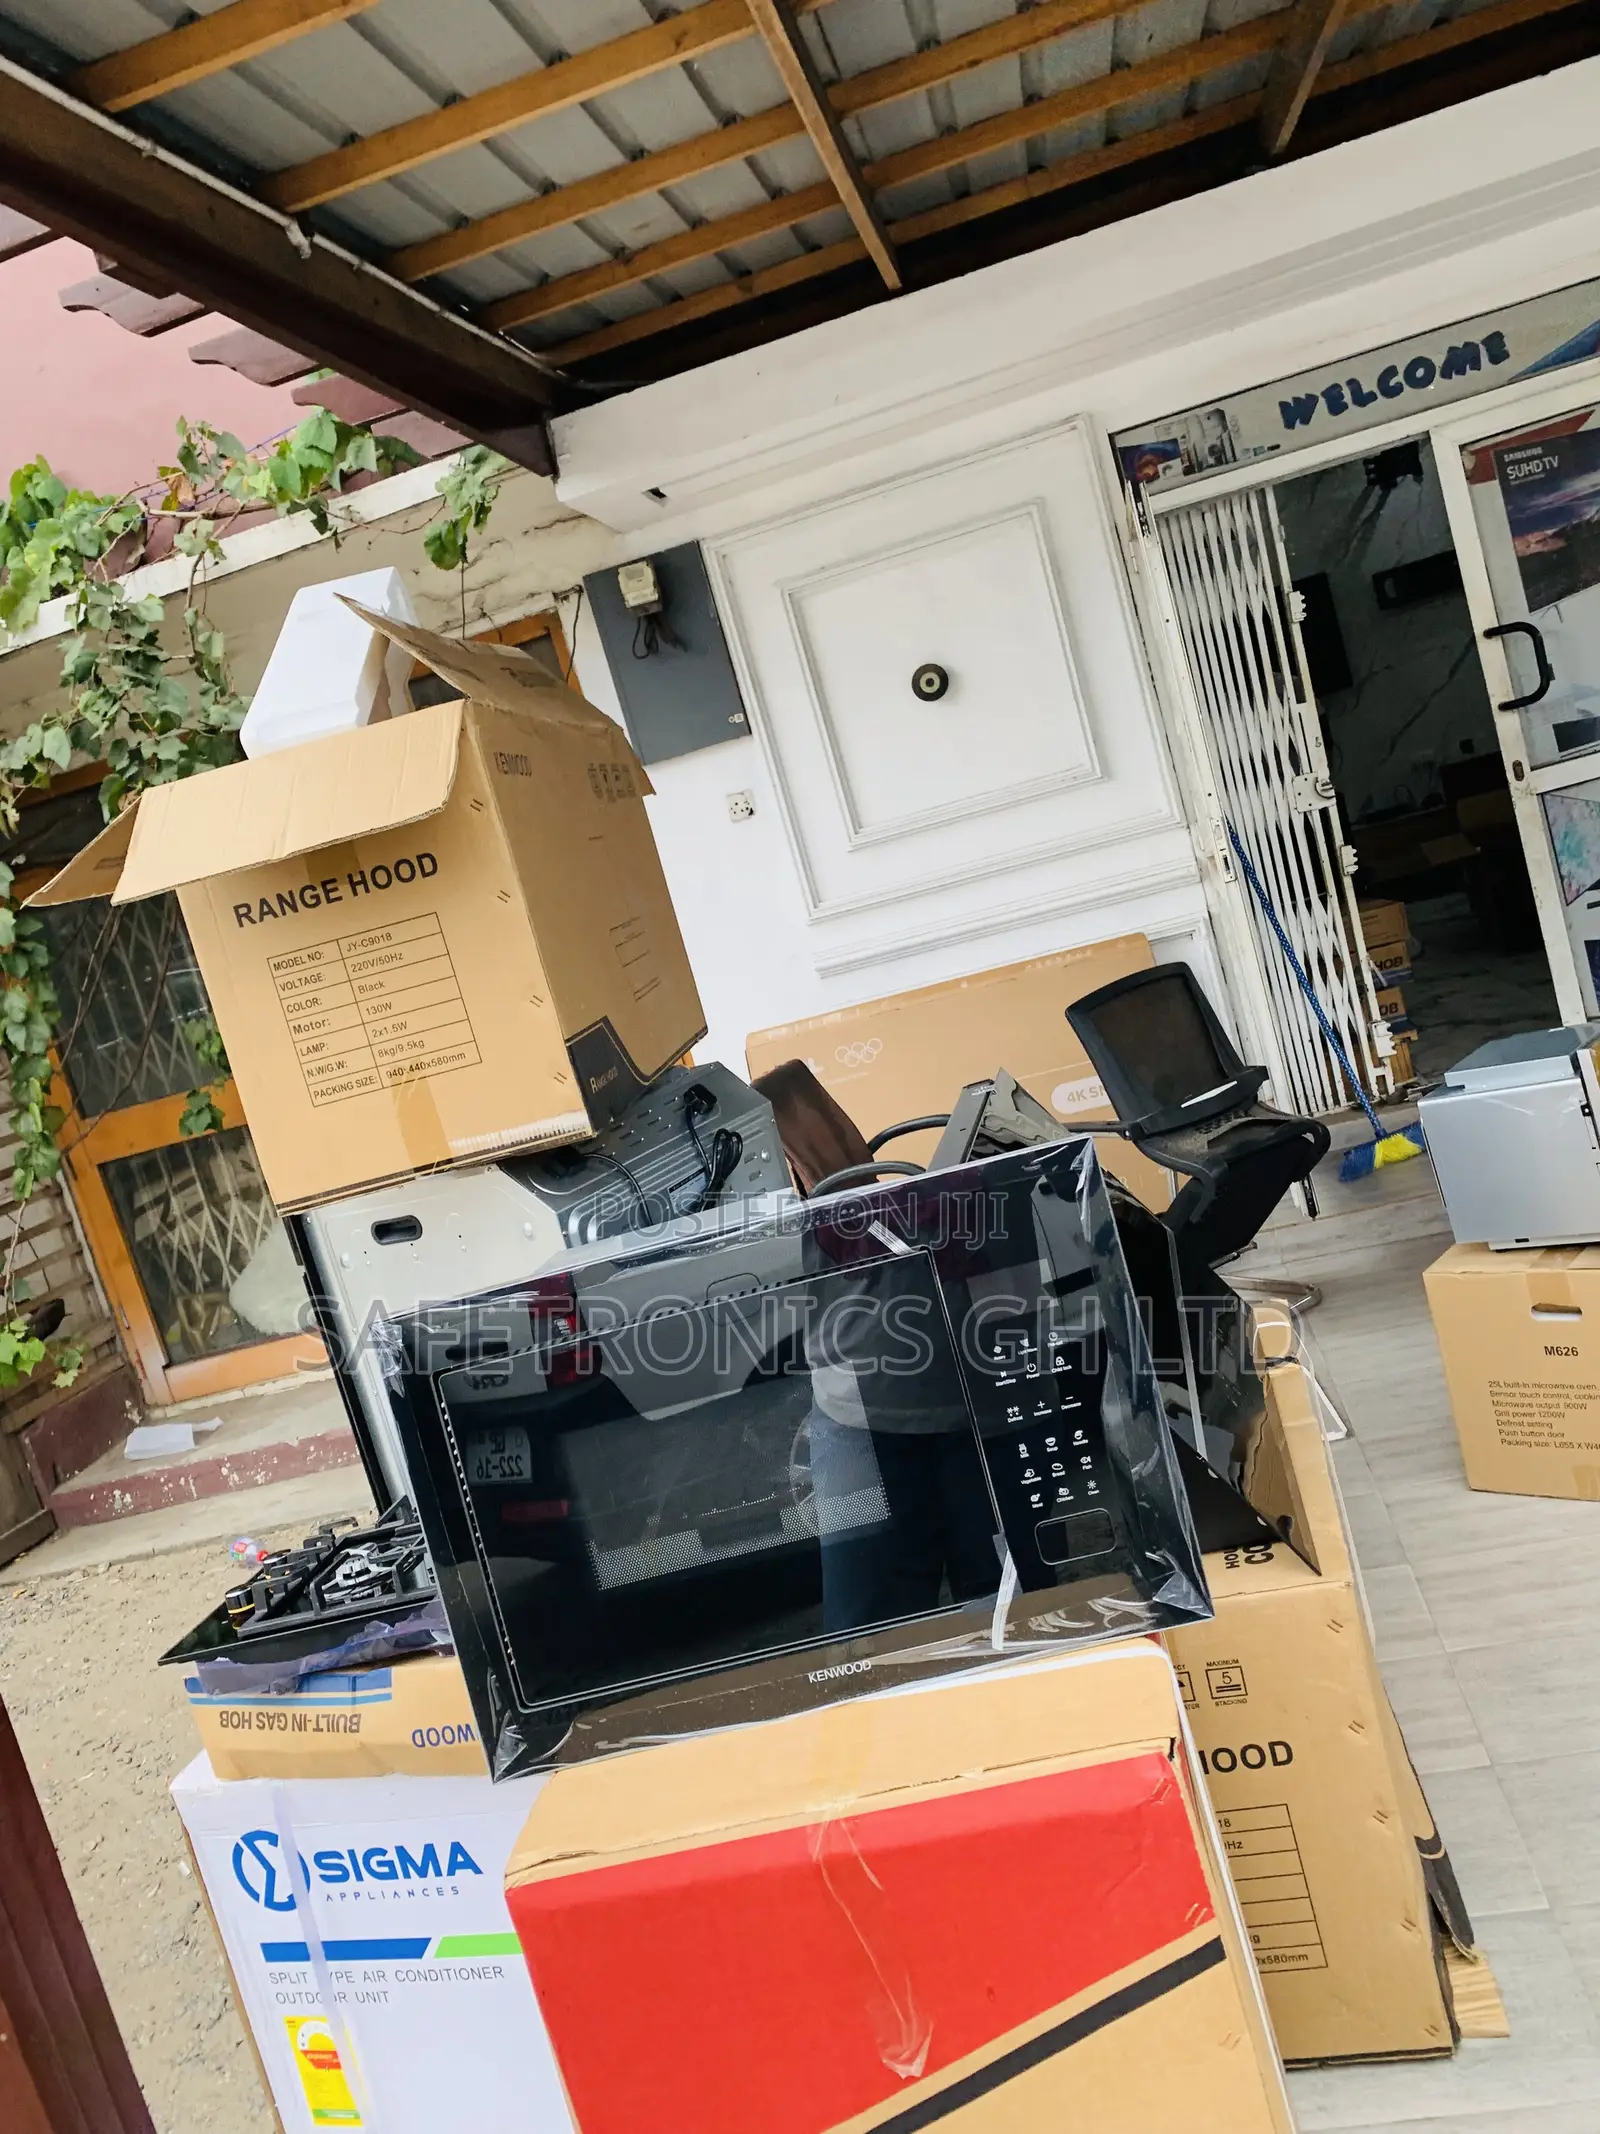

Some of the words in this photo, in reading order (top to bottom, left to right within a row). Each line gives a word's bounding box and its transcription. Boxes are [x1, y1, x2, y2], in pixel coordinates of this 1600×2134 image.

[1278, 330, 1511, 430] WELCOME
[1506, 459, 1543, 480] SUHD
[1542, 455, 1559, 470] TV
[233, 878, 343, 928] RANGE
[347, 852, 439, 898] HOOD
[346, 932, 393, 953] JY-C9018
[273, 956, 308, 972] MODEL
[307, 950, 325, 962] NO:
[351, 952, 404, 973] 220V/50Hz
[279, 972, 327, 992] VOLTAGE:
[358, 980, 386, 994] Black
[286, 996, 323, 1014] COLOR:
[365, 1001, 393, 1016] 130W
[1379, 1002, 1400, 1017] OB
[292, 1018, 331, 1035] Motor:
[371, 1020, 408, 1038] 2x1.5W
[300, 1042, 330, 1057] LAMP:
[377, 1039, 426, 1058] 8kg/9.5kg
[306, 1060, 349, 1079] N.W/G.W:
[313, 1083, 355, 1100] PACKING
[355, 1075, 379, 1088] SIZE:
[1067, 1088, 1088, 1103] 4K
[1543, 1346, 1579, 1356] M626
[1518, 1391, 1541, 1399] touch
[1531, 1382, 1575, 1390] microwave
[1491, 1400, 1534, 1408] Microwave
[1511, 1411, 1536, 1419] power
[1496, 1419, 1525, 1427] Defrost
[1526, 1420, 1554, 1430] setting
[1498, 1428, 1519, 1436] Push
[1520, 1430, 1546, 1438] button
[1500, 1438, 1533, 1448] Packing
[808, 1660, 872, 1684] KENWOOD
[1206, 1659, 1240, 1667] MAXIMUM
[1221, 1671, 1232, 1684] 5
[219, 1710, 251, 1729] HOB
[255, 1711, 289, 1731] GAS
[291, 1712, 362, 1733] BUILT-IN
[411, 1722, 478, 1748] WOOD
[313, 1841, 484, 1884] SIGMA
[325, 1886, 460, 1902] APPLIANCES
[269, 1972, 308, 1985] SPLIT
[362, 1970, 388, 1984] AIR
[394, 1966, 505, 1983] CONDITIONER
[355, 1990, 390, 2004] UNIT
